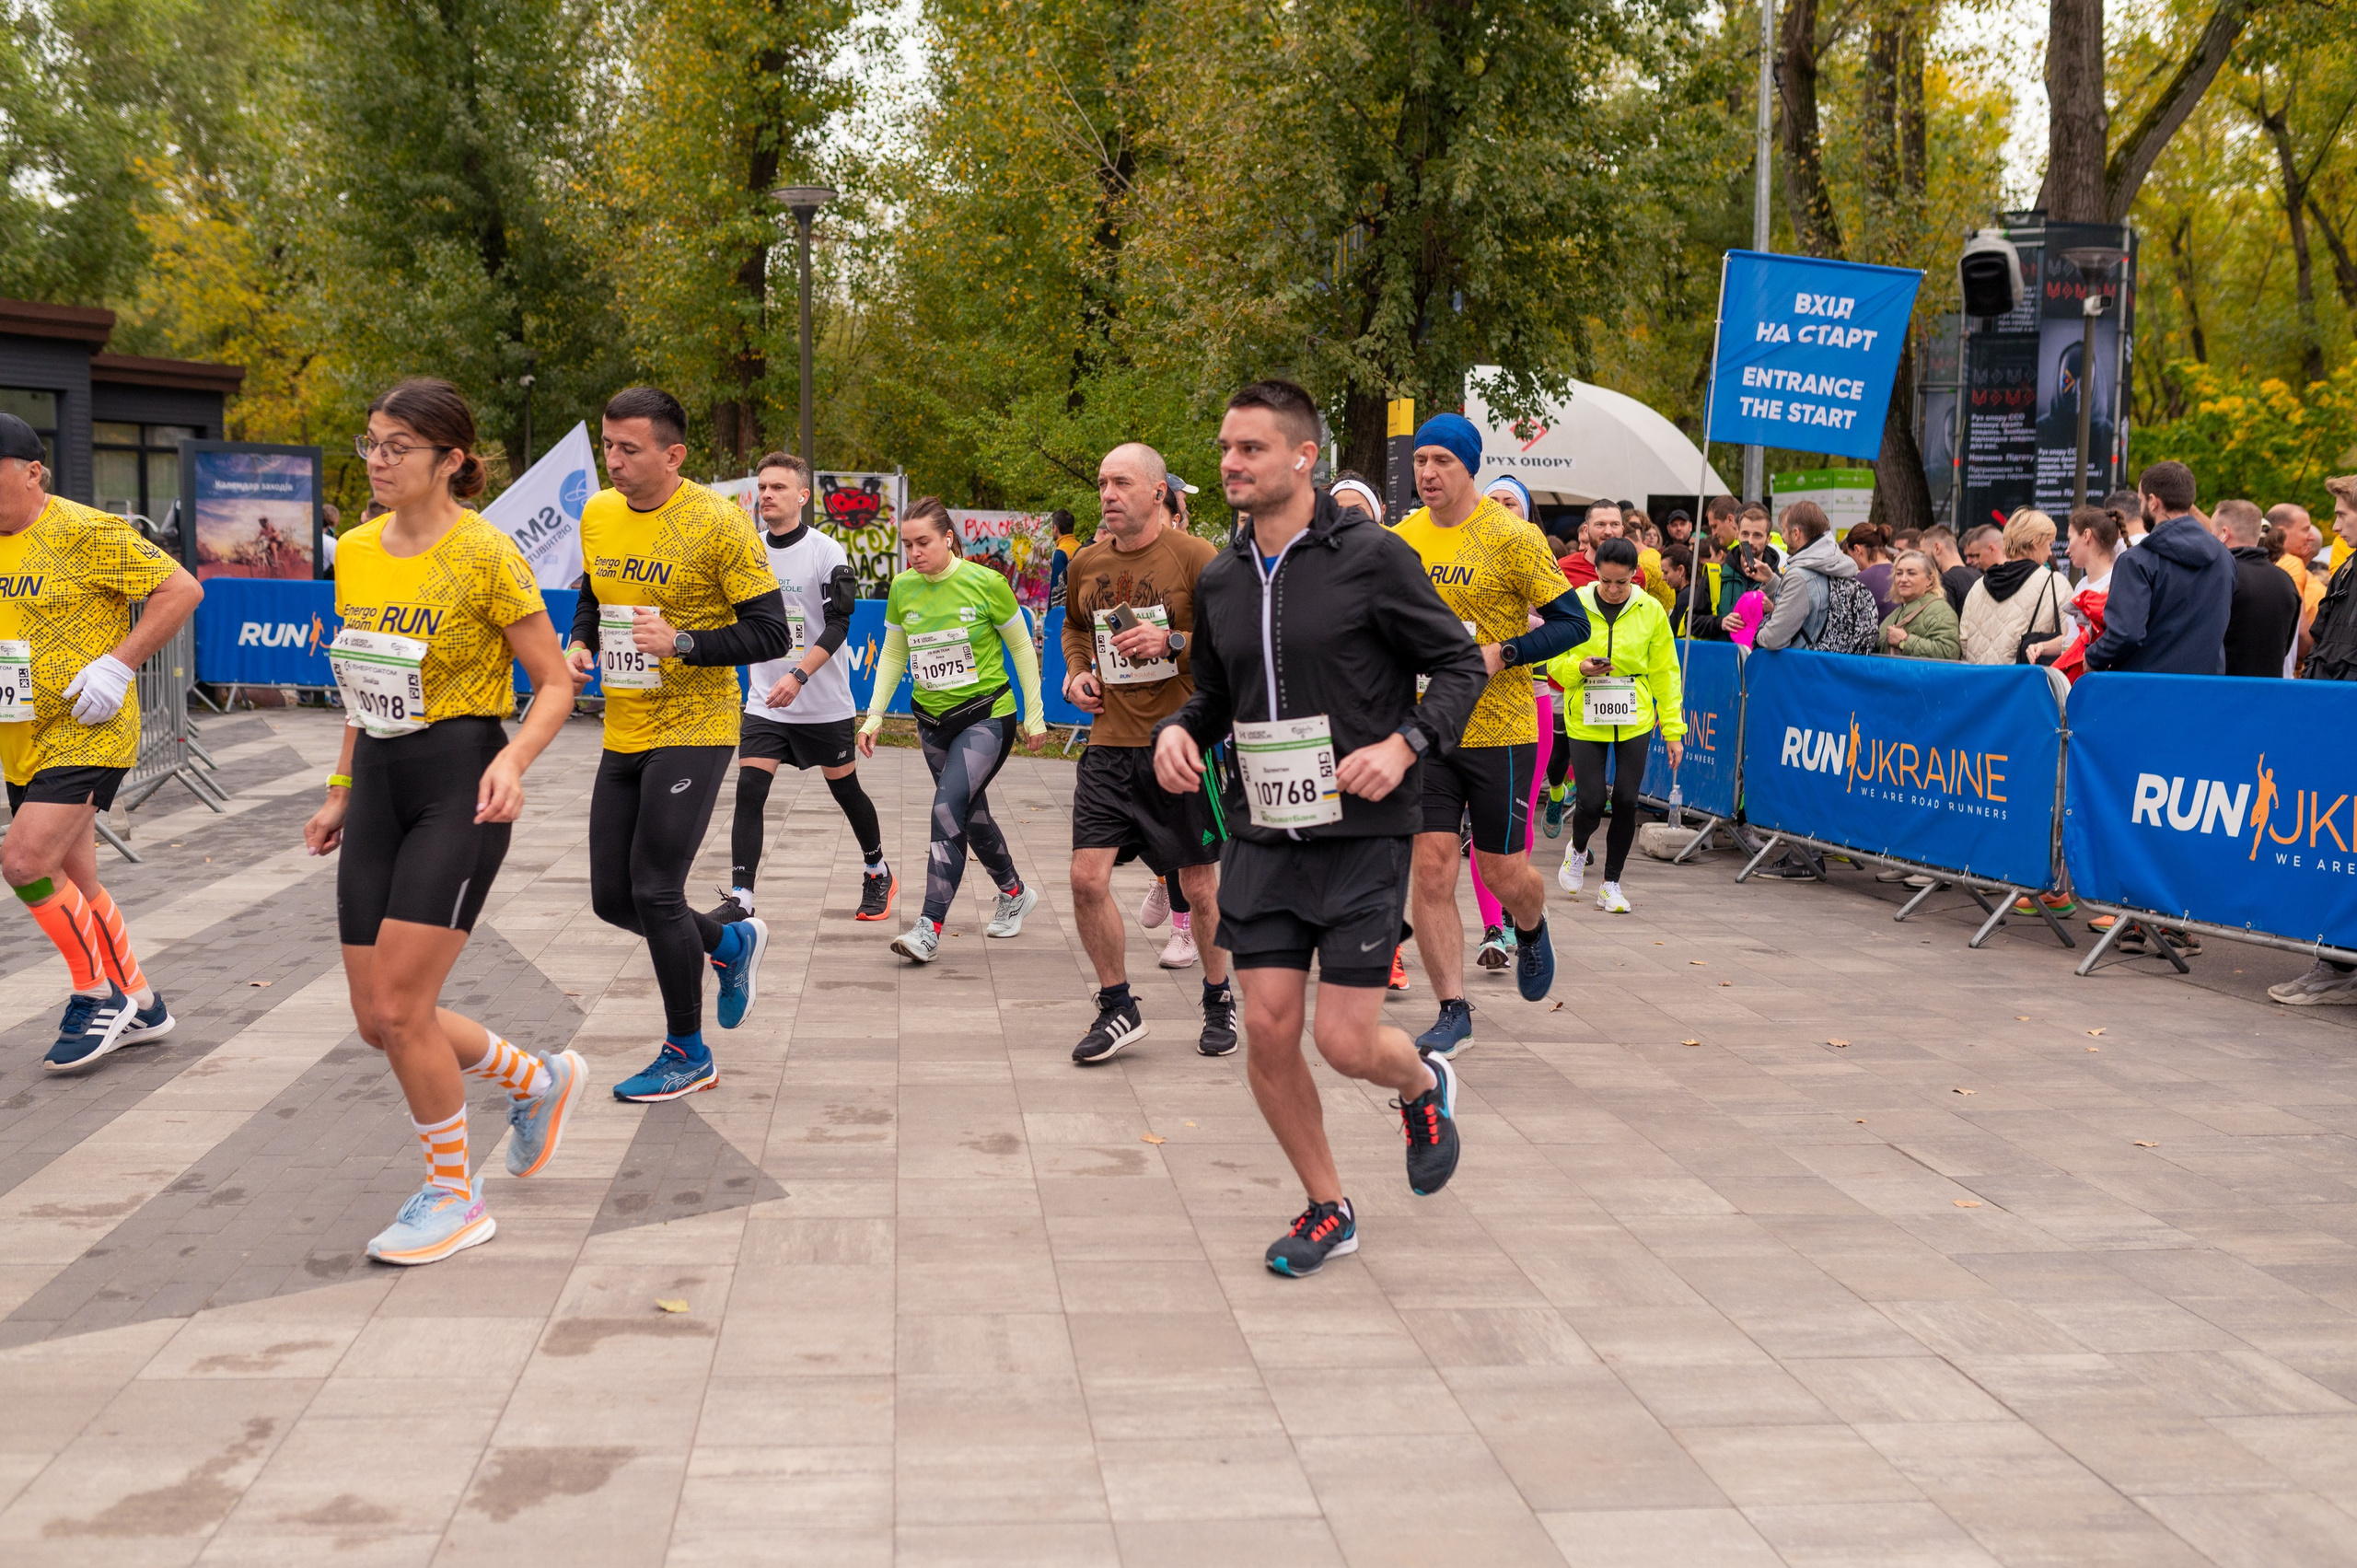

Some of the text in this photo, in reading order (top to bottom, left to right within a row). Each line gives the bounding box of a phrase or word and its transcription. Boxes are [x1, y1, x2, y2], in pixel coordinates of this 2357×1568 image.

[1794, 293, 1855, 319] ВХІД
[1756, 321, 1878, 352] НА СТАРТ
[1742, 366, 1865, 401] ENTRANCE
[1739, 396, 1857, 430] THE START
[1486, 456, 1573, 468] РУХ ОПОРУ
[215, 480, 293, 492] Календар заходів
[595, 555, 621, 567] Energo
[595, 567, 617, 578] Atom
[621, 558, 673, 586] RUN
[1430, 565, 1475, 586] RUN
[344, 604, 377, 621] Energo
[346, 618, 372, 630] Atom
[378, 606, 444, 635] RUN
[238, 621, 308, 648] RUN
[604, 650, 644, 672] 10195
[923, 659, 964, 679] 10975
[354, 688, 405, 720] 10198
[1594, 703, 1629, 714] 10800
[1686, 751, 1715, 766] RUNNERS
[1781, 726, 1847, 776] RUN
[1255, 779, 1317, 806] 10768
[1860, 786, 2007, 820] WE ARE ROAD RUNNERS
[2131, 772, 2251, 838] RUN
[2276, 853, 2356, 876] WE ARE
